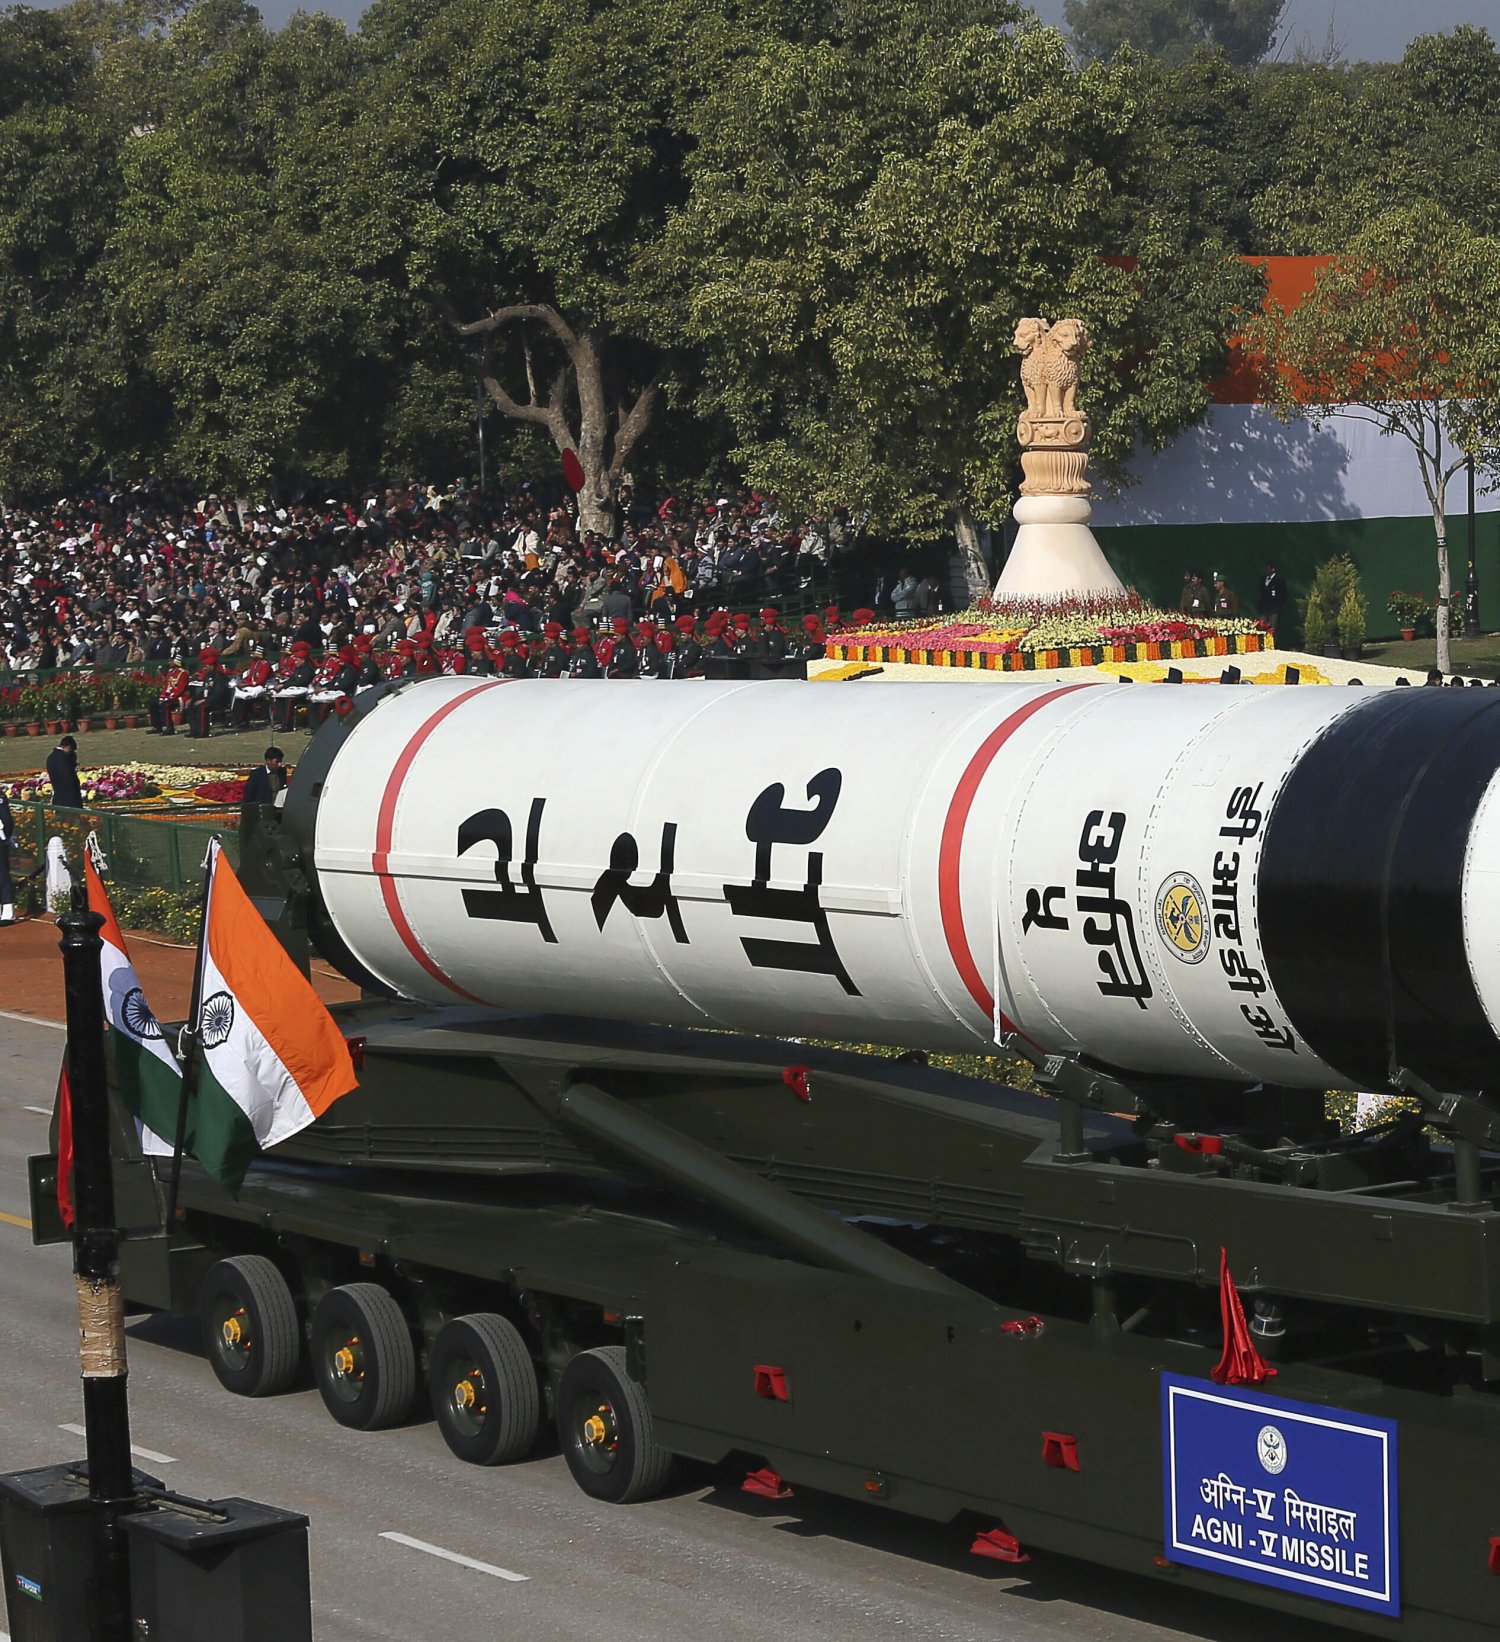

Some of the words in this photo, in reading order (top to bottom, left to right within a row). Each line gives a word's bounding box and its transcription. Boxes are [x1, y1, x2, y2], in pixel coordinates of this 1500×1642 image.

[1218, 781, 1264, 845] डी
[1076, 809, 1153, 1010] अग्नि
[1212, 851, 1242, 946] आर
[1218, 948, 1267, 998] डी
[1239, 1003, 1299, 1054] ओ
[1191, 1513, 1243, 1550] AGNI
[1282, 1536, 1369, 1580] MISSILE
[1283, 1487, 1357, 1543] मिसाइल
